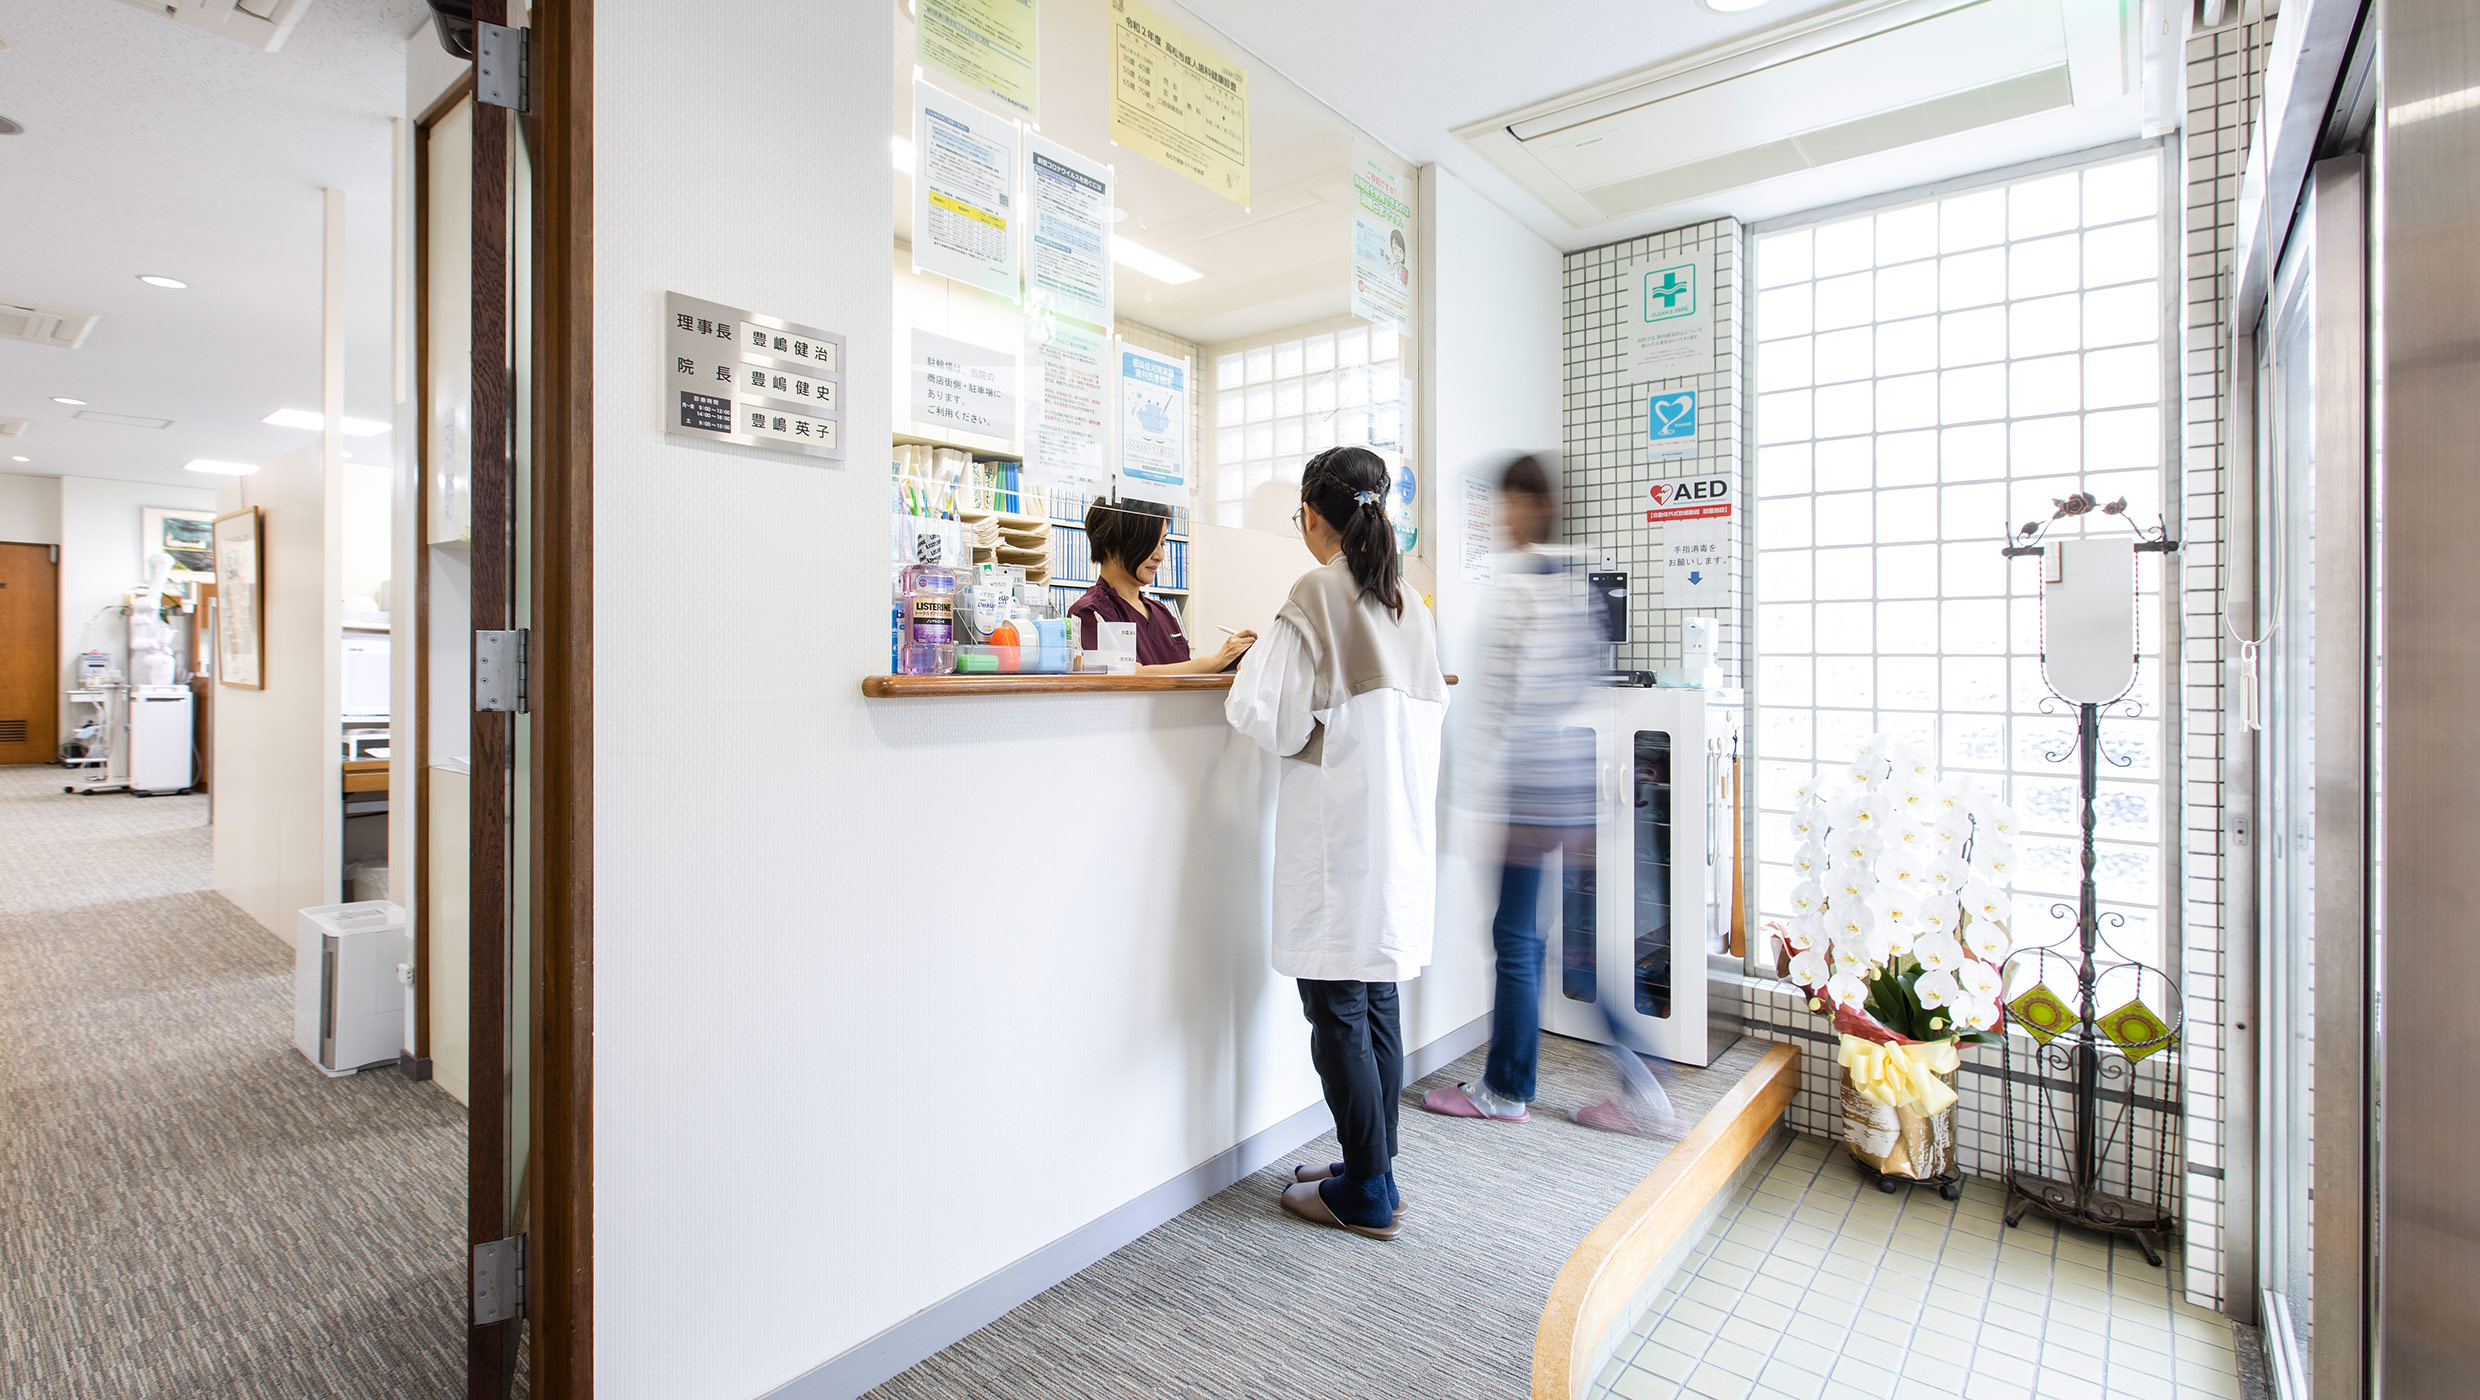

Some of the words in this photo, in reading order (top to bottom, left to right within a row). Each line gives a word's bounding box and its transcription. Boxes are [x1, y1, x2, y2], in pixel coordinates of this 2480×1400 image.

[1651, 308, 1669, 318] CLEAN
[1674, 305, 1689, 313] SAFE
[677, 313, 732, 341] 理事長
[752, 331, 828, 362] 豊嶋健治
[677, 357, 732, 383] 院長
[927, 356, 995, 382] 駐輪場は、当院の
[751, 371, 830, 401] 豊嶋健史
[927, 372, 1001, 398] 商店街側・駐車場に
[693, 395, 719, 406] 診療時間
[927, 388, 965, 406] あります。
[751, 412, 829, 439] 豊嶋英子
[927, 404, 991, 427] ご利用ください。
[1674, 480, 1728, 501] AED
[1673, 544, 1717, 554] 手指消毒を
[1668, 556, 1727, 567] お願いします。
[916, 602, 952, 612] LISTERINE
